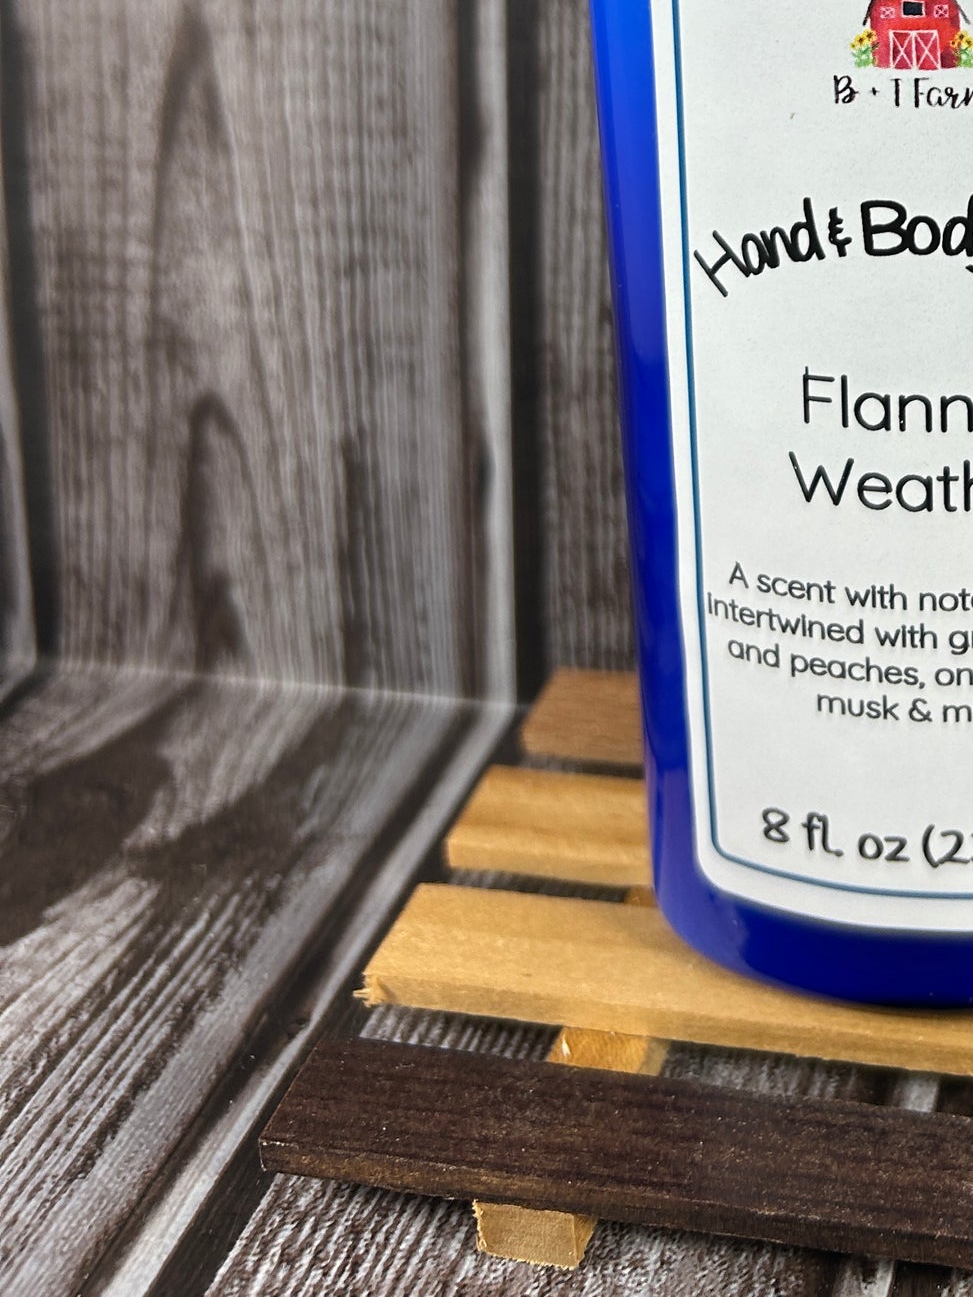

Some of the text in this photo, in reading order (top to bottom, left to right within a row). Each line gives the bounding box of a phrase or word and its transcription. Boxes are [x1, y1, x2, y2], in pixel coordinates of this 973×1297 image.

[833, 74, 860, 105] B
[693, 196, 826, 298] Hand
[827, 206, 853, 258] &
[728, 561, 749, 589] A
[756, 574, 837, 604] scent
[844, 583, 908, 611] with
[874, 622, 938, 650] with
[727, 640, 780, 669] and
[790, 653, 926, 690] peaches,
[934, 667, 973, 687] on
[817, 694, 900, 721] musk
[908, 697, 933, 723] &
[761, 808, 790, 844] 8
[857, 834, 910, 863] oz
